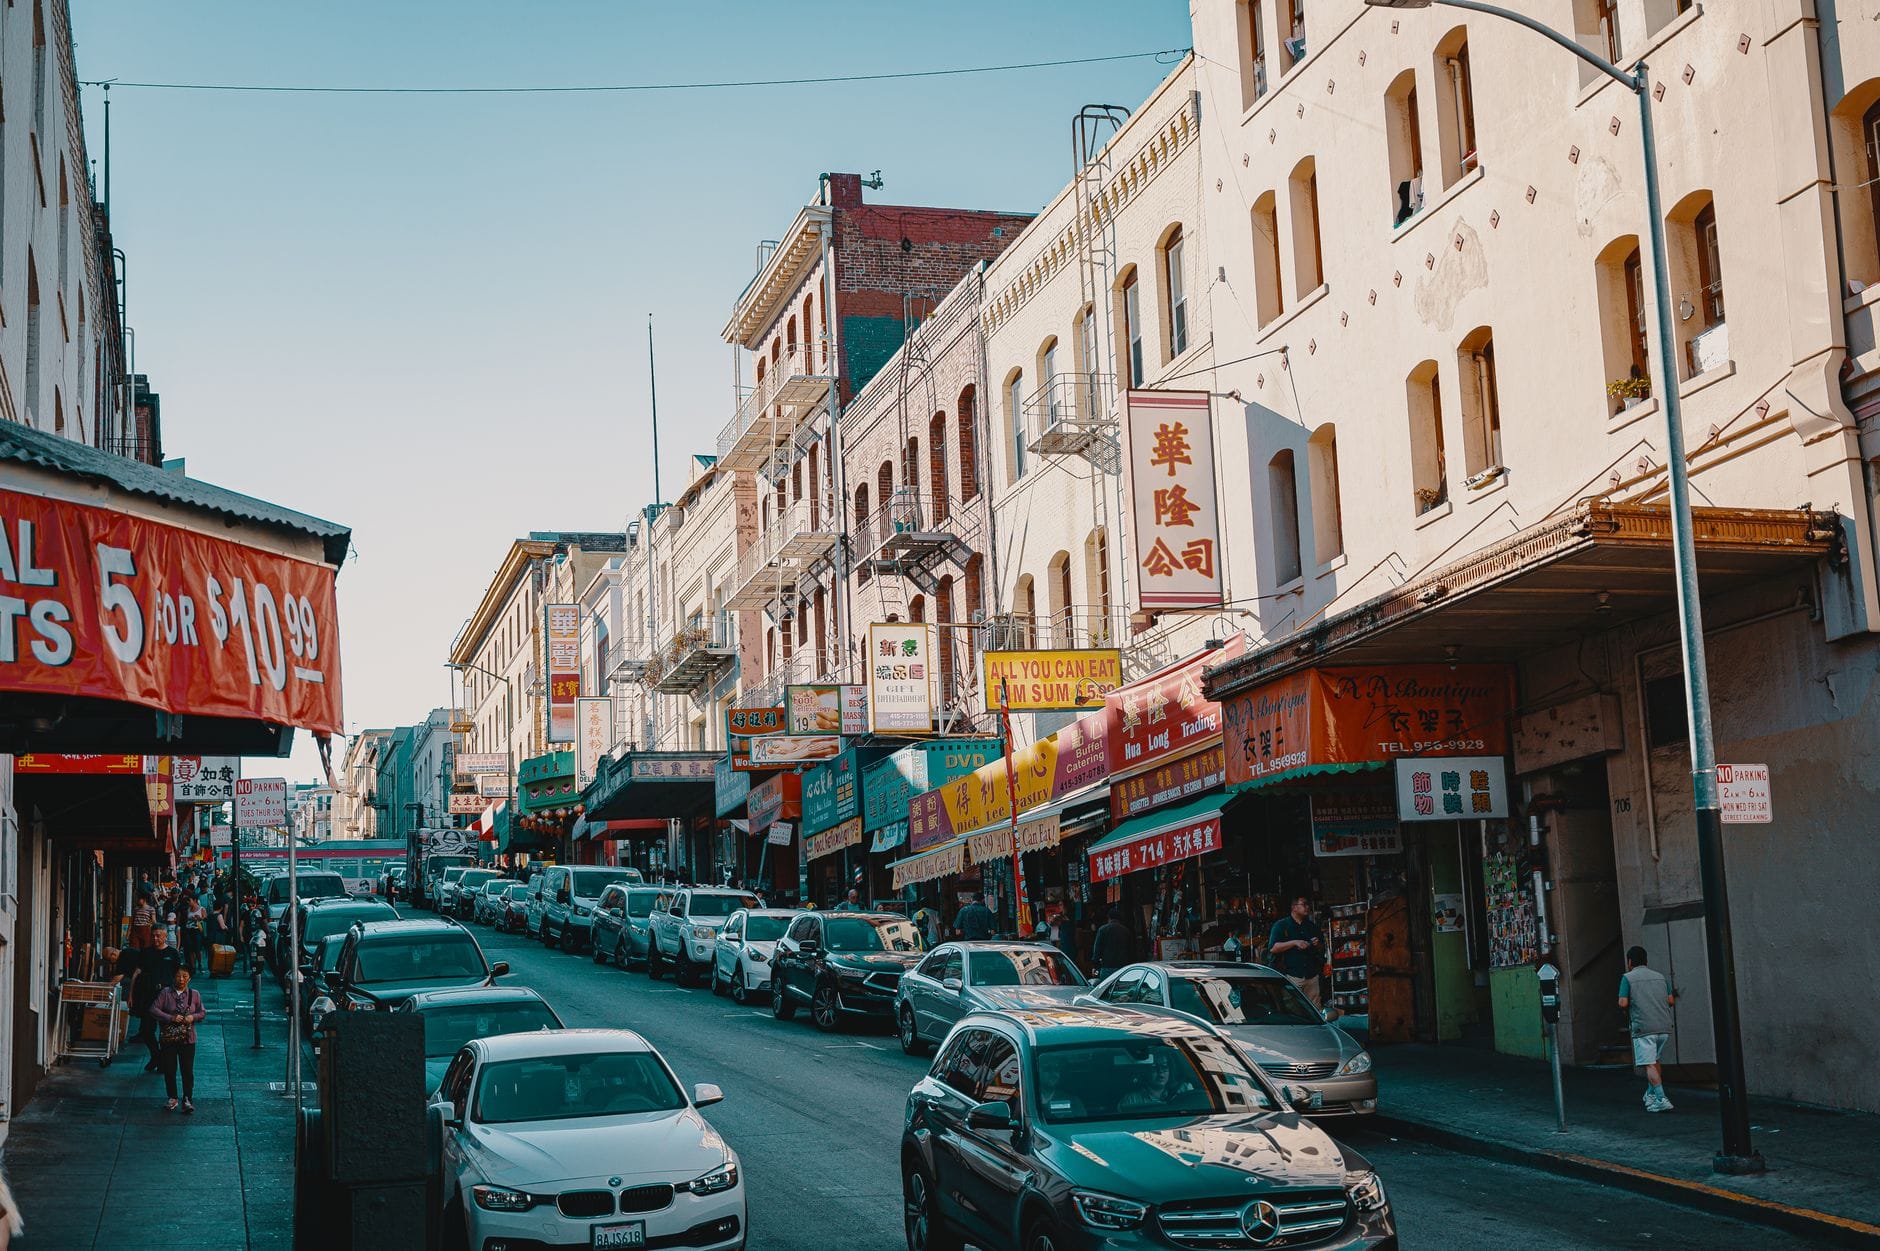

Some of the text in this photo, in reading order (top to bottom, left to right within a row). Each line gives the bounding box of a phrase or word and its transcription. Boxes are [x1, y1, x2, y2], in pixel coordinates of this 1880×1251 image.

[97, 543, 144, 664] 5
[155, 586, 199, 647] FOR
[990, 658, 1116, 680] ALL YOU CAN EAT
[849, 687, 863, 695] THE
[886, 685, 914, 693] GIFT
[1031, 683, 1070, 702] SUM
[1394, 678, 1494, 705] Boutique
[792, 695, 814, 705] Foot
[1388, 709, 1465, 733] 衣架子
[1124, 713, 1217, 760] Hua Long Trading
[1075, 739, 1104, 759] Buffet
[945, 753, 986, 769] DVD
[1066, 751, 1105, 774] Catering
[1718, 767, 1767, 782] NO PARKING
[237, 781, 285, 794] NO PARKING
[1723, 787, 1729, 798] 2
[1748, 787, 1755, 798] 6
[241, 797, 247, 806] 2
[265, 796, 271, 805] 6
[1614, 798, 1631, 814] 706
[1723, 802, 1767, 812] MON WED FRI SAT
[240, 808, 284, 817] TUES THUR SUN
[1022, 827, 1038, 847] Can
[1140, 840, 1164, 864] 714
[596, 1230, 641, 1248] 8AJS618
